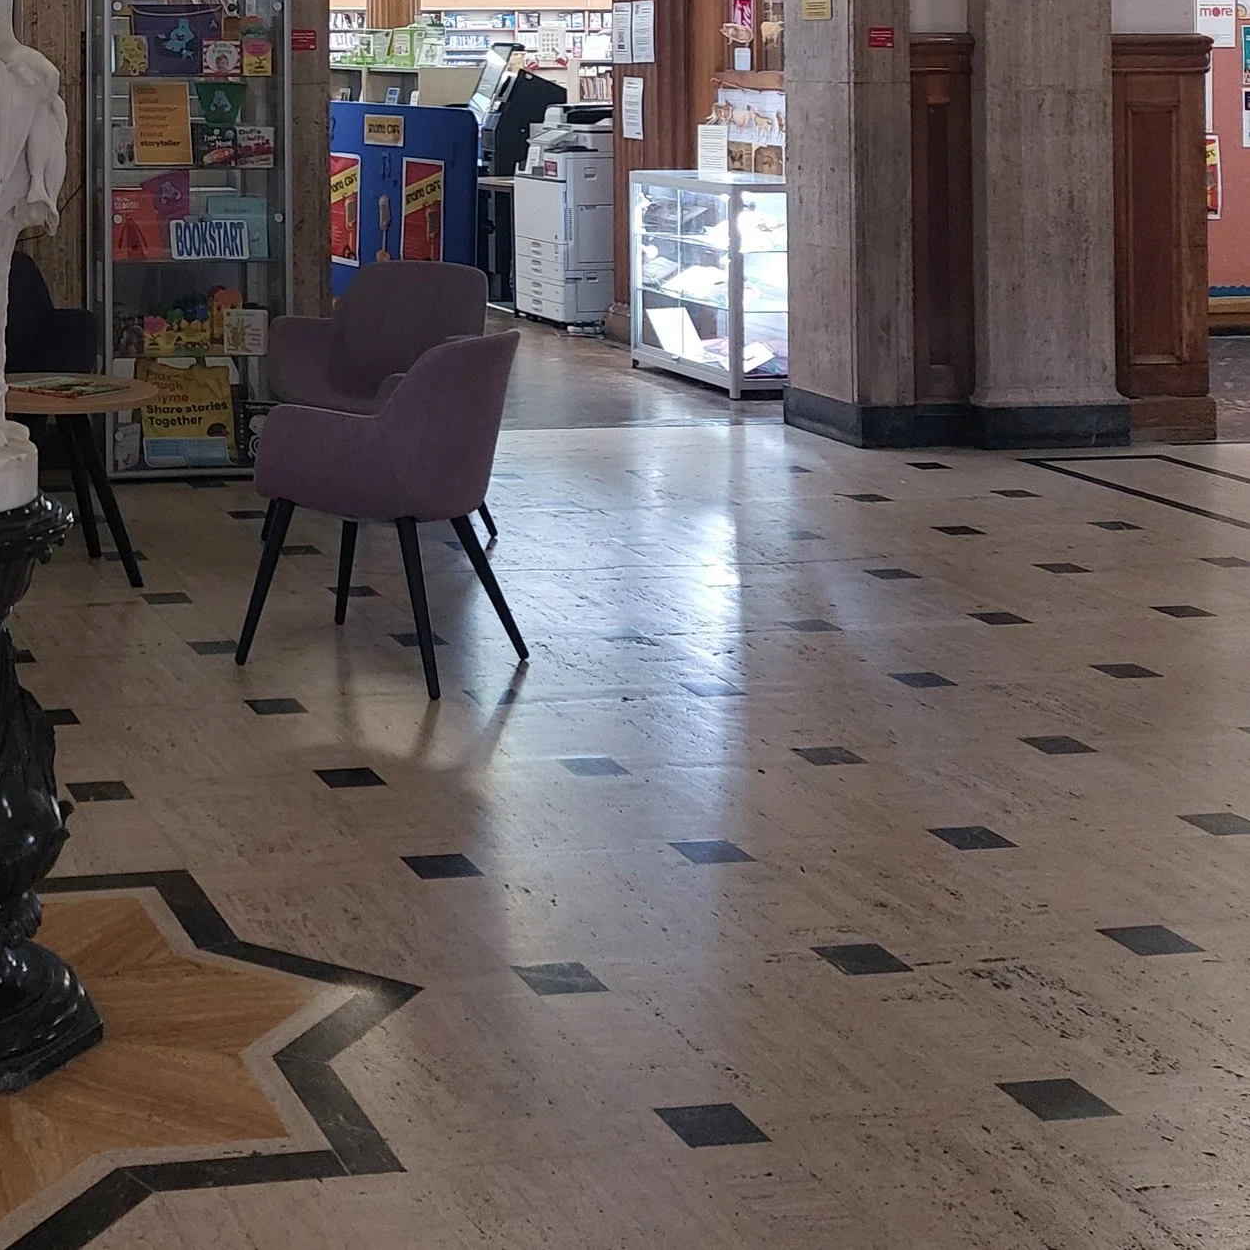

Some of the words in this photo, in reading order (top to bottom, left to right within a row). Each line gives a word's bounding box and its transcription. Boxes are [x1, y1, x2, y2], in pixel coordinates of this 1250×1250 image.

[140, 139, 181, 148] storyteller
[175, 221, 245, 258] BOOKSTART
[152, 381, 184, 392] augh
[146, 404, 183, 414] Share
[186, 401, 228, 413] stories
[148, 415, 204, 428] Together
